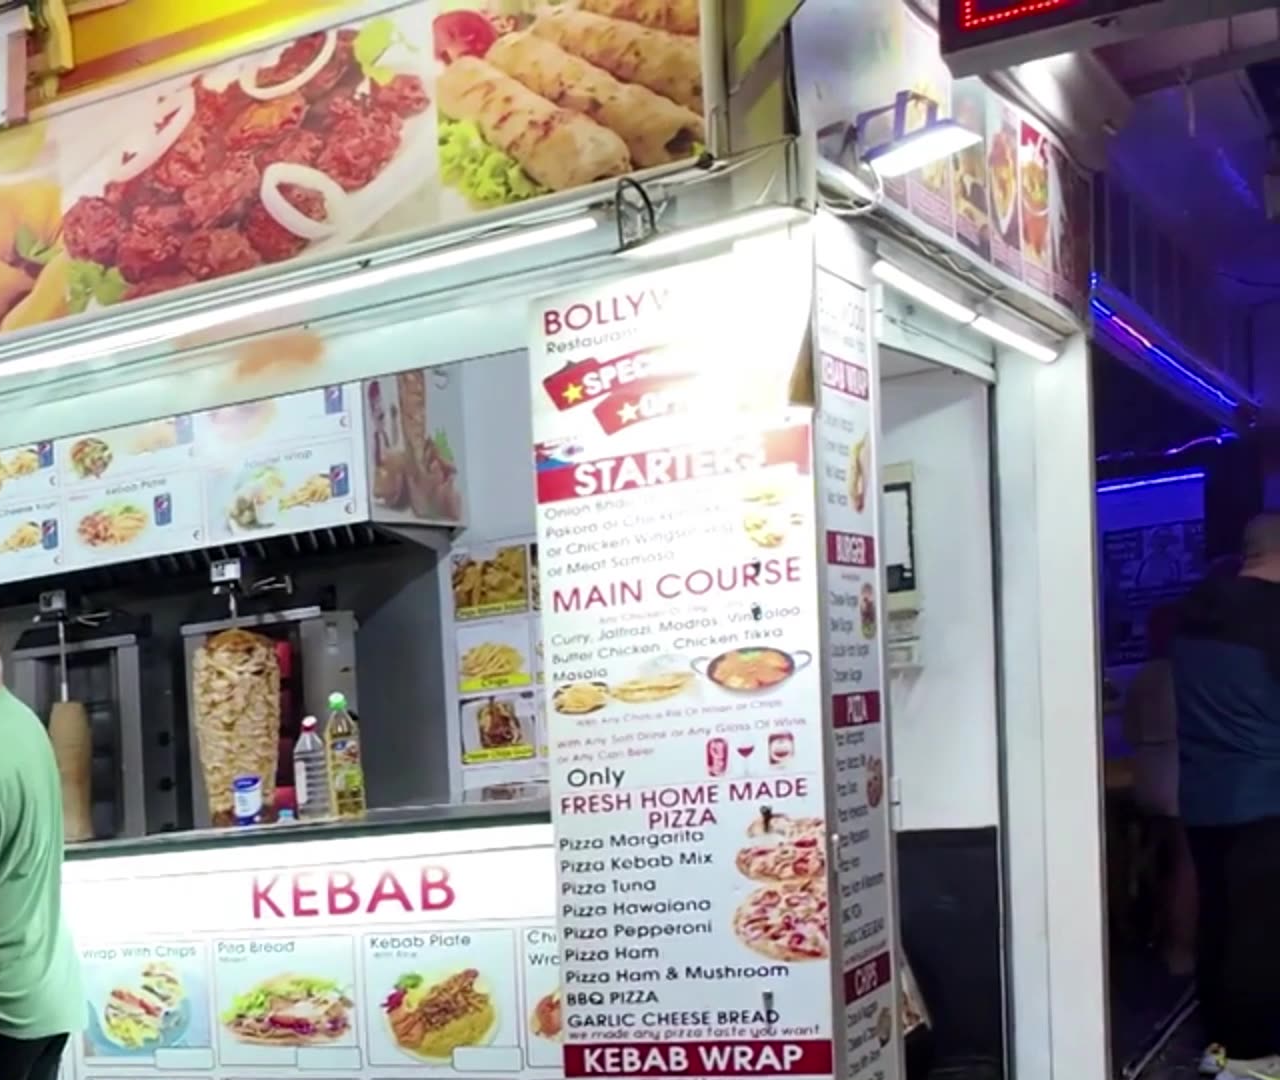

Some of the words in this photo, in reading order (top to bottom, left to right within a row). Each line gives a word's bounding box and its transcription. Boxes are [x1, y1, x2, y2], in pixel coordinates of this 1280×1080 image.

[546, 522, 599, 540] Pakora
[566, 533, 631, 556] Chicken
[566, 559, 607, 577] Meat
[553, 579, 643, 614] MAIN
[656, 556, 801, 600] COURSE
[551, 647, 593, 665] Butter
[597, 640, 661, 658] Chicken
[672, 630, 739, 649] Chicken
[743, 627, 784, 642] Tikka
[552, 667, 608, 683] Masala
[567, 766, 625, 789] Only
[561, 793, 632, 816] FRESH
[641, 785, 720, 810] HOME
[729, 777, 808, 802] MADE
[648, 807, 718, 830] PIZZA
[559, 837, 604, 851] Pizza
[610, 829, 705, 850] Margarita
[561, 859, 605, 873] Pizza
[611, 853, 674, 871] Kebab
[679, 851, 714, 866] Mix
[252, 864, 458, 919] KEBAB
[562, 880, 606, 895] Pizza
[612, 878, 657, 893] Tuna
[563, 903, 608, 918] Pizza
[613, 898, 712, 916] Hawaiana
[564, 925, 609, 940] Pizza
[614, 920, 713, 939] Pepperoni
[154, 944, 198, 959] Chips
[369, 936, 425, 950] Kebab
[429, 934, 472, 949] Plate
[565, 948, 610, 962] Pizza
[615, 946, 660, 960] Ham
[566, 971, 611, 984] Pizza
[616, 968, 661, 983] Ham
[665, 967, 679, 981] &
[685, 964, 790, 980] Mushroom
[567, 992, 605, 1006] BBQ
[609, 990, 660, 1005] PIZZA
[567, 1012, 644, 1028] GARLIC
[648, 1010, 711, 1026] CHEESE
[717, 1008, 780, 1025] BREAD
[591, 1028, 630, 1040] made
[633, 1028, 661, 1042] any
[781, 1024, 820, 1036] want
[584, 1046, 689, 1074] KEBAB
[698, 1044, 804, 1072] WRAP
